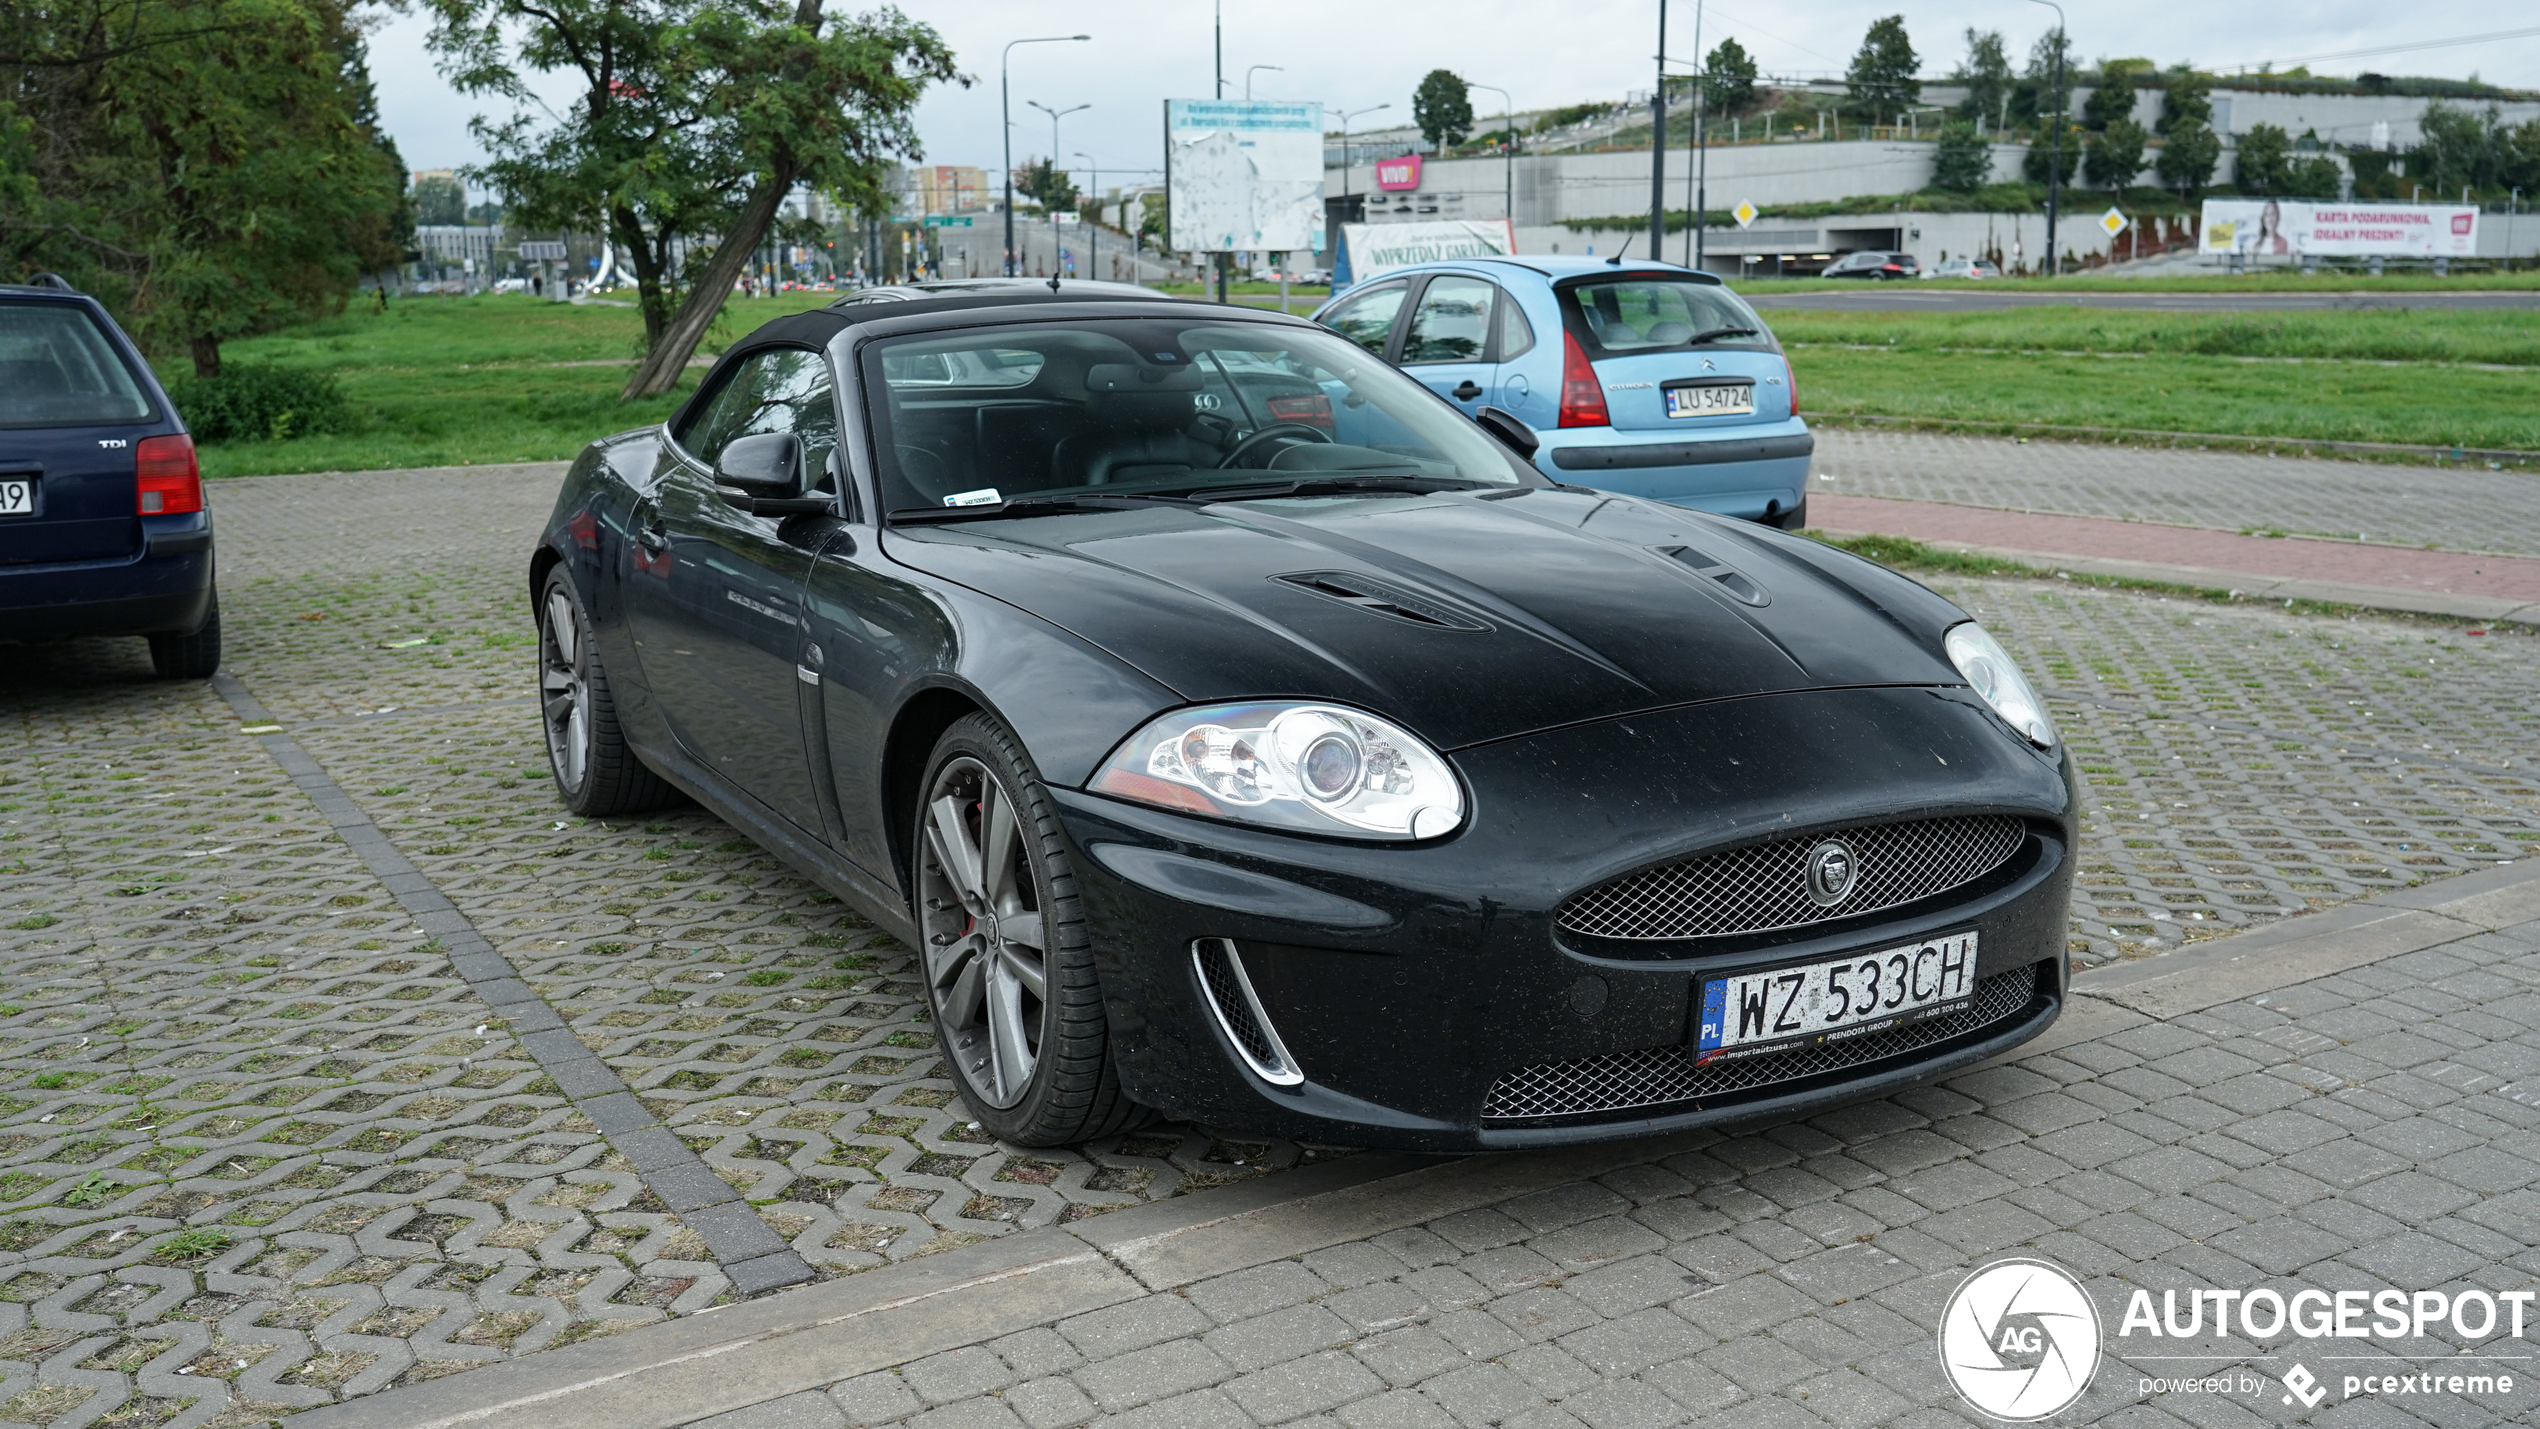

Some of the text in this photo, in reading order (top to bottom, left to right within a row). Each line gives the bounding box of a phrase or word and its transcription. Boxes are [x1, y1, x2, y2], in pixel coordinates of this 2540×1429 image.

[1380, 165, 1413, 184] VIVO!
[2315, 211, 2349, 224] KARTA
[2313, 228, 2356, 241] IDEALNY
[1766, 376, 1782, 385] C3
[1677, 388, 1749, 410] LU 54724
[98, 439, 127, 449] TDI
[1737, 938, 1968, 1039] WZ 533CH
[1913, 1001, 1969, 1021] +48 600 200 436
[1701, 1023, 1720, 1040] PL
[1826, 1019, 1894, 1042] PRENDOTA GROUP
